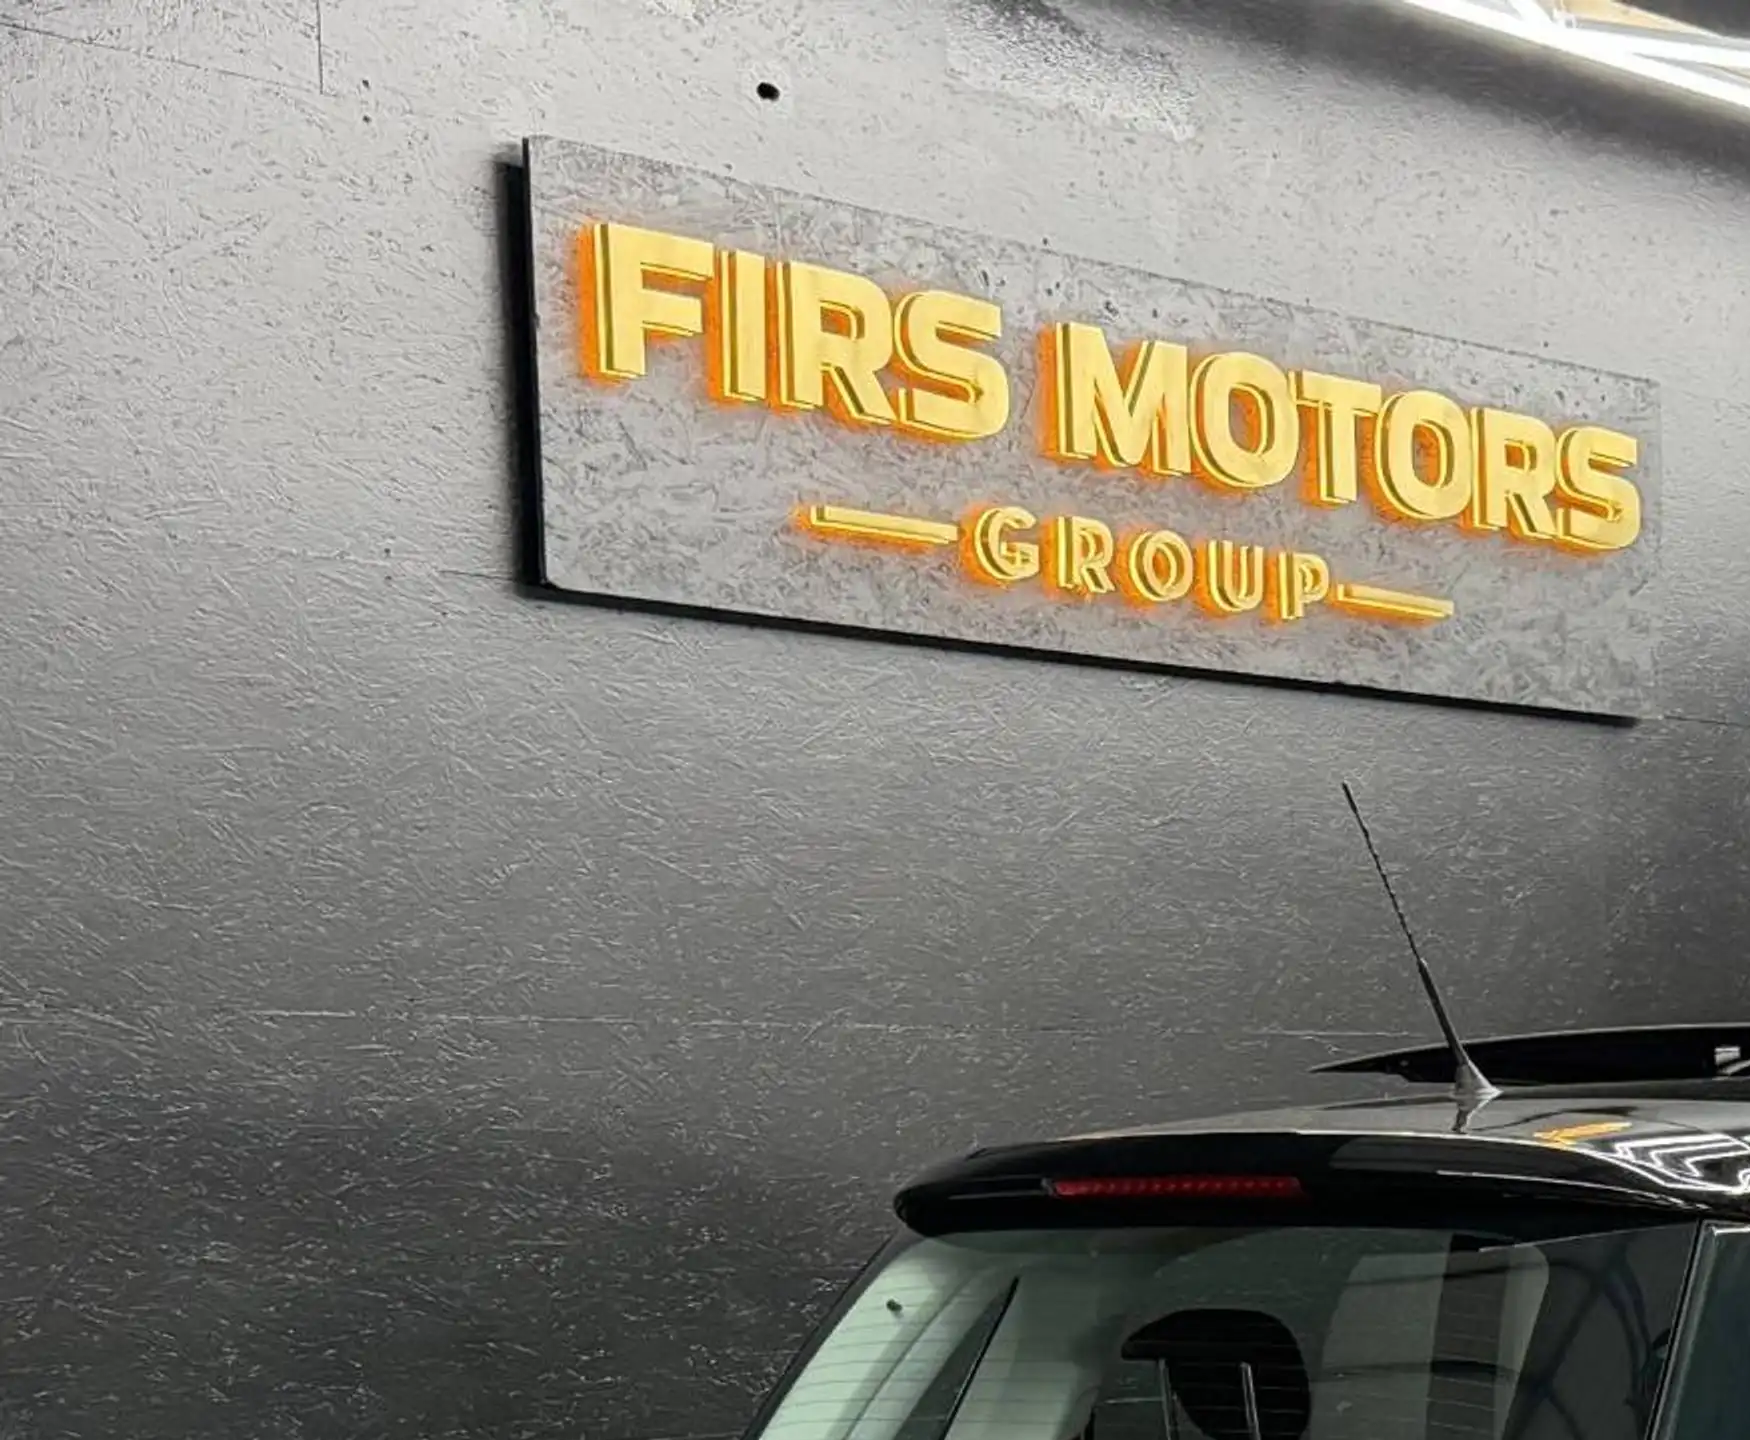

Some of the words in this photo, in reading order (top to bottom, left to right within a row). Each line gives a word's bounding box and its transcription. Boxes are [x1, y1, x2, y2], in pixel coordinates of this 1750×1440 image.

[592, 222, 1011, 440] FIRS
[1045, 322, 1641, 551] MOTORS
[975, 505, 1332, 618] GROUP
